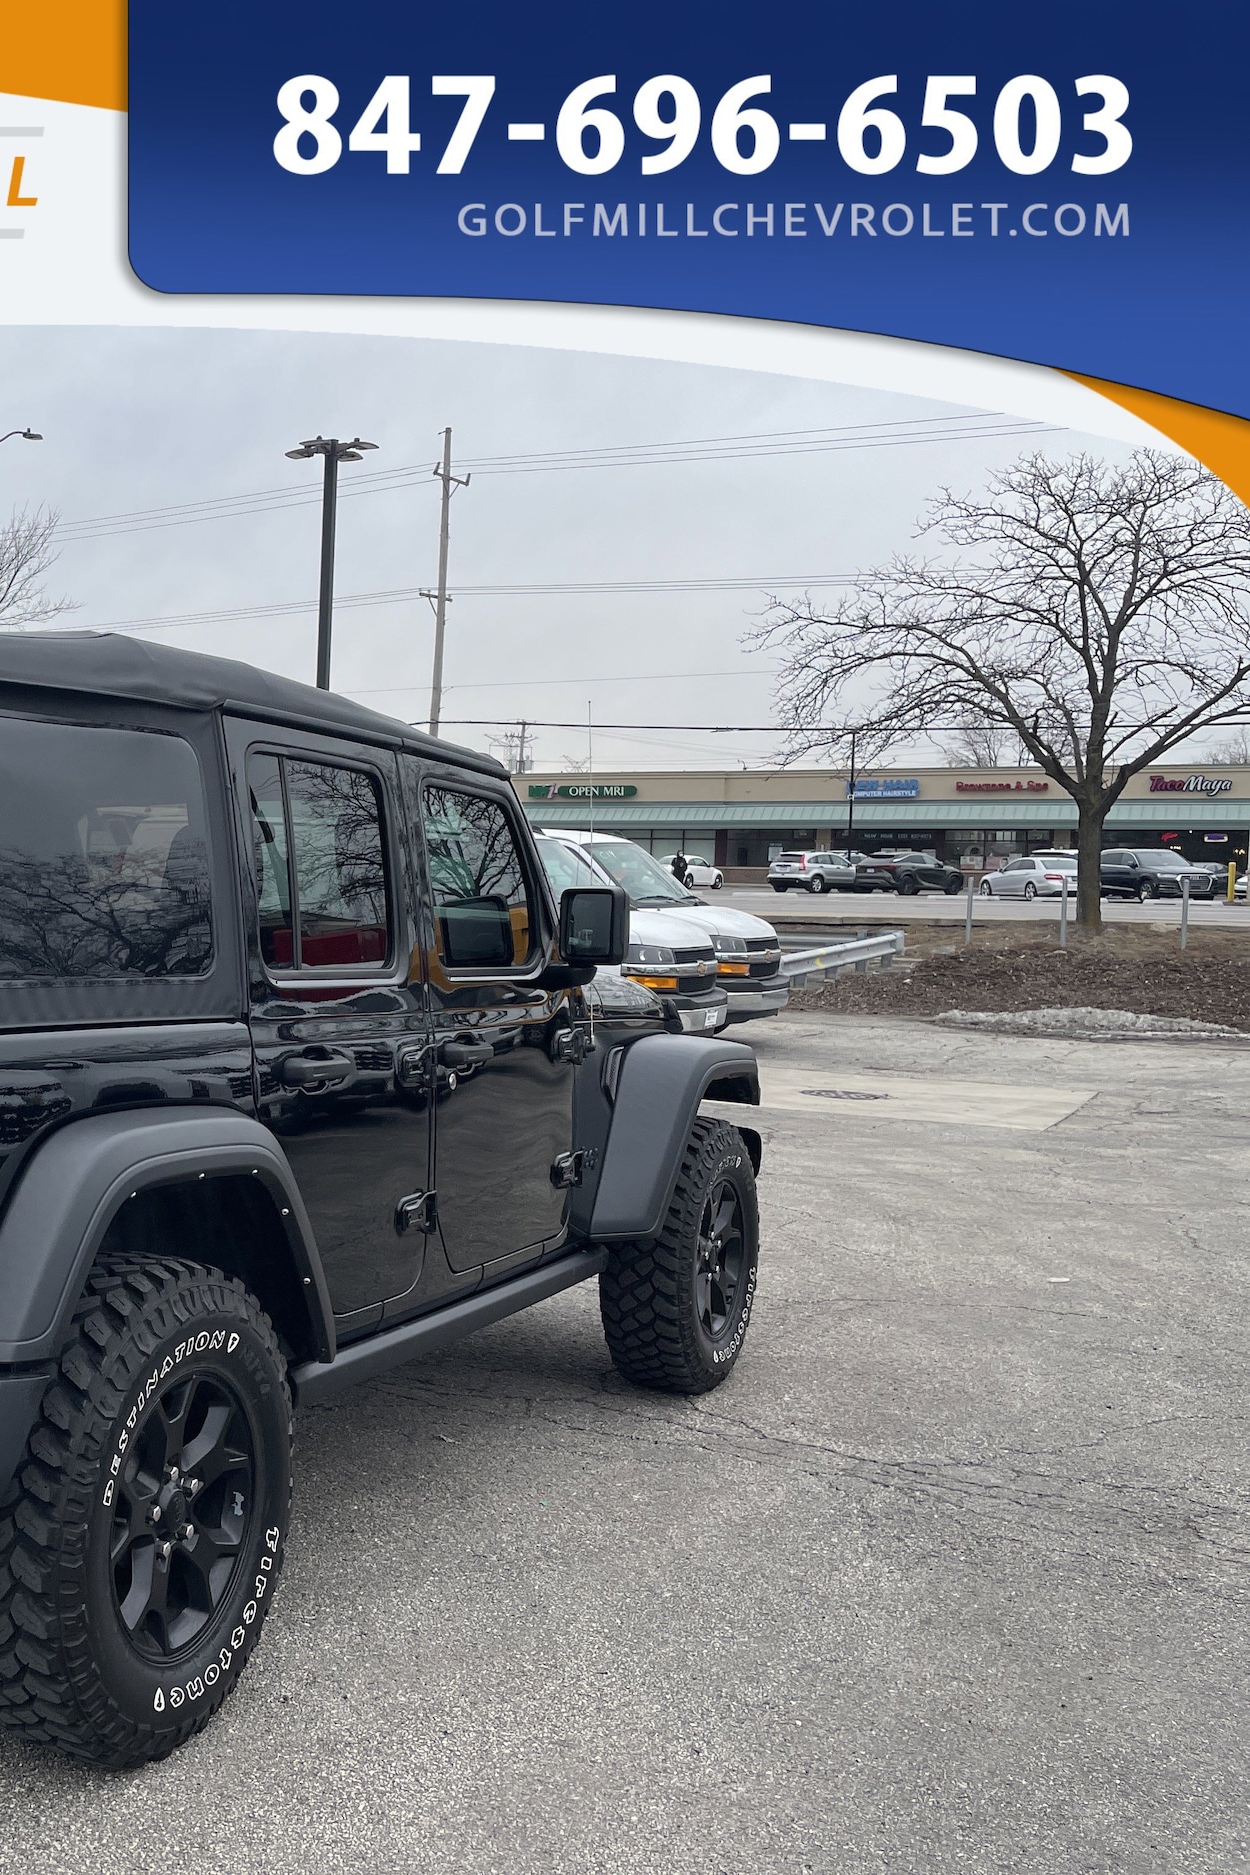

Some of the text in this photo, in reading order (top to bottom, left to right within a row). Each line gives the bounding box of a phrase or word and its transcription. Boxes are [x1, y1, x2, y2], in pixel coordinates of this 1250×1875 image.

[569, 787, 625, 796] OPEN MRI
[103, 1329, 226, 1506] DESTINATION
